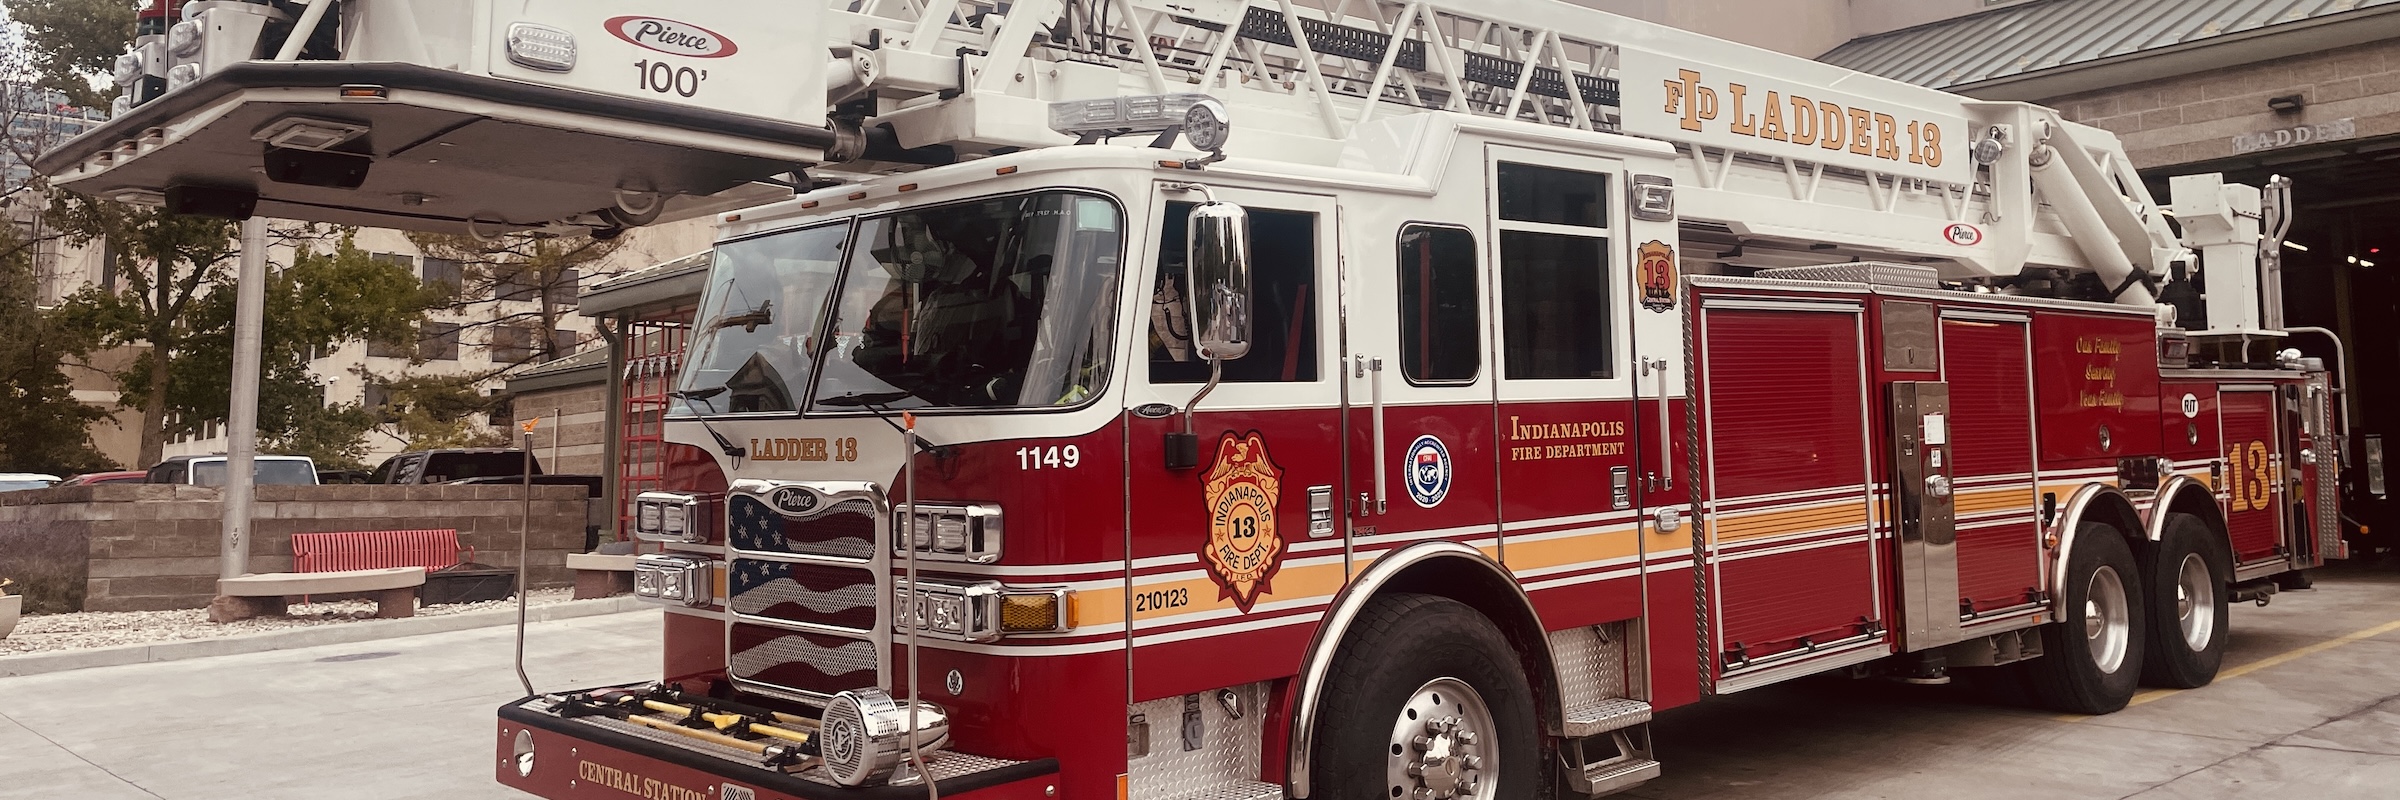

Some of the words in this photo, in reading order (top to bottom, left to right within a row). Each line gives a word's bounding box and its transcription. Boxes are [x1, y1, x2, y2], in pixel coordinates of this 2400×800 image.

[635, 20, 708, 50] Pierce
[634, 58, 707, 98] 100'
[1729, 82, 1900, 162] LADDER
[1907, 120, 1943, 168] 13
[1952, 226, 1974, 241] Pierce
[1643, 259, 1671, 291] 13
[2184, 399, 2196, 413] RIT
[1510, 415, 1625, 440] INDIANAPOLIS
[750, 437, 828, 462] LADDER
[835, 436, 858, 462] 13
[1016, 444, 1080, 470] 1149
[1511, 446, 1542, 461] FIRE
[1546, 442, 1625, 459] DEPARTMENT
[2229, 440, 2270, 512] 13
[777, 488, 812, 508] Pierce
[1215, 486, 1271, 526] INDIANAPOLIS
[1232, 516, 1256, 539] 13
[1219, 544, 1240, 570] FIRE
[1243, 542, 1270, 570] DEPT.
[1135, 587, 1188, 612] 210123
[579, 759, 641, 796] CENTRAL
